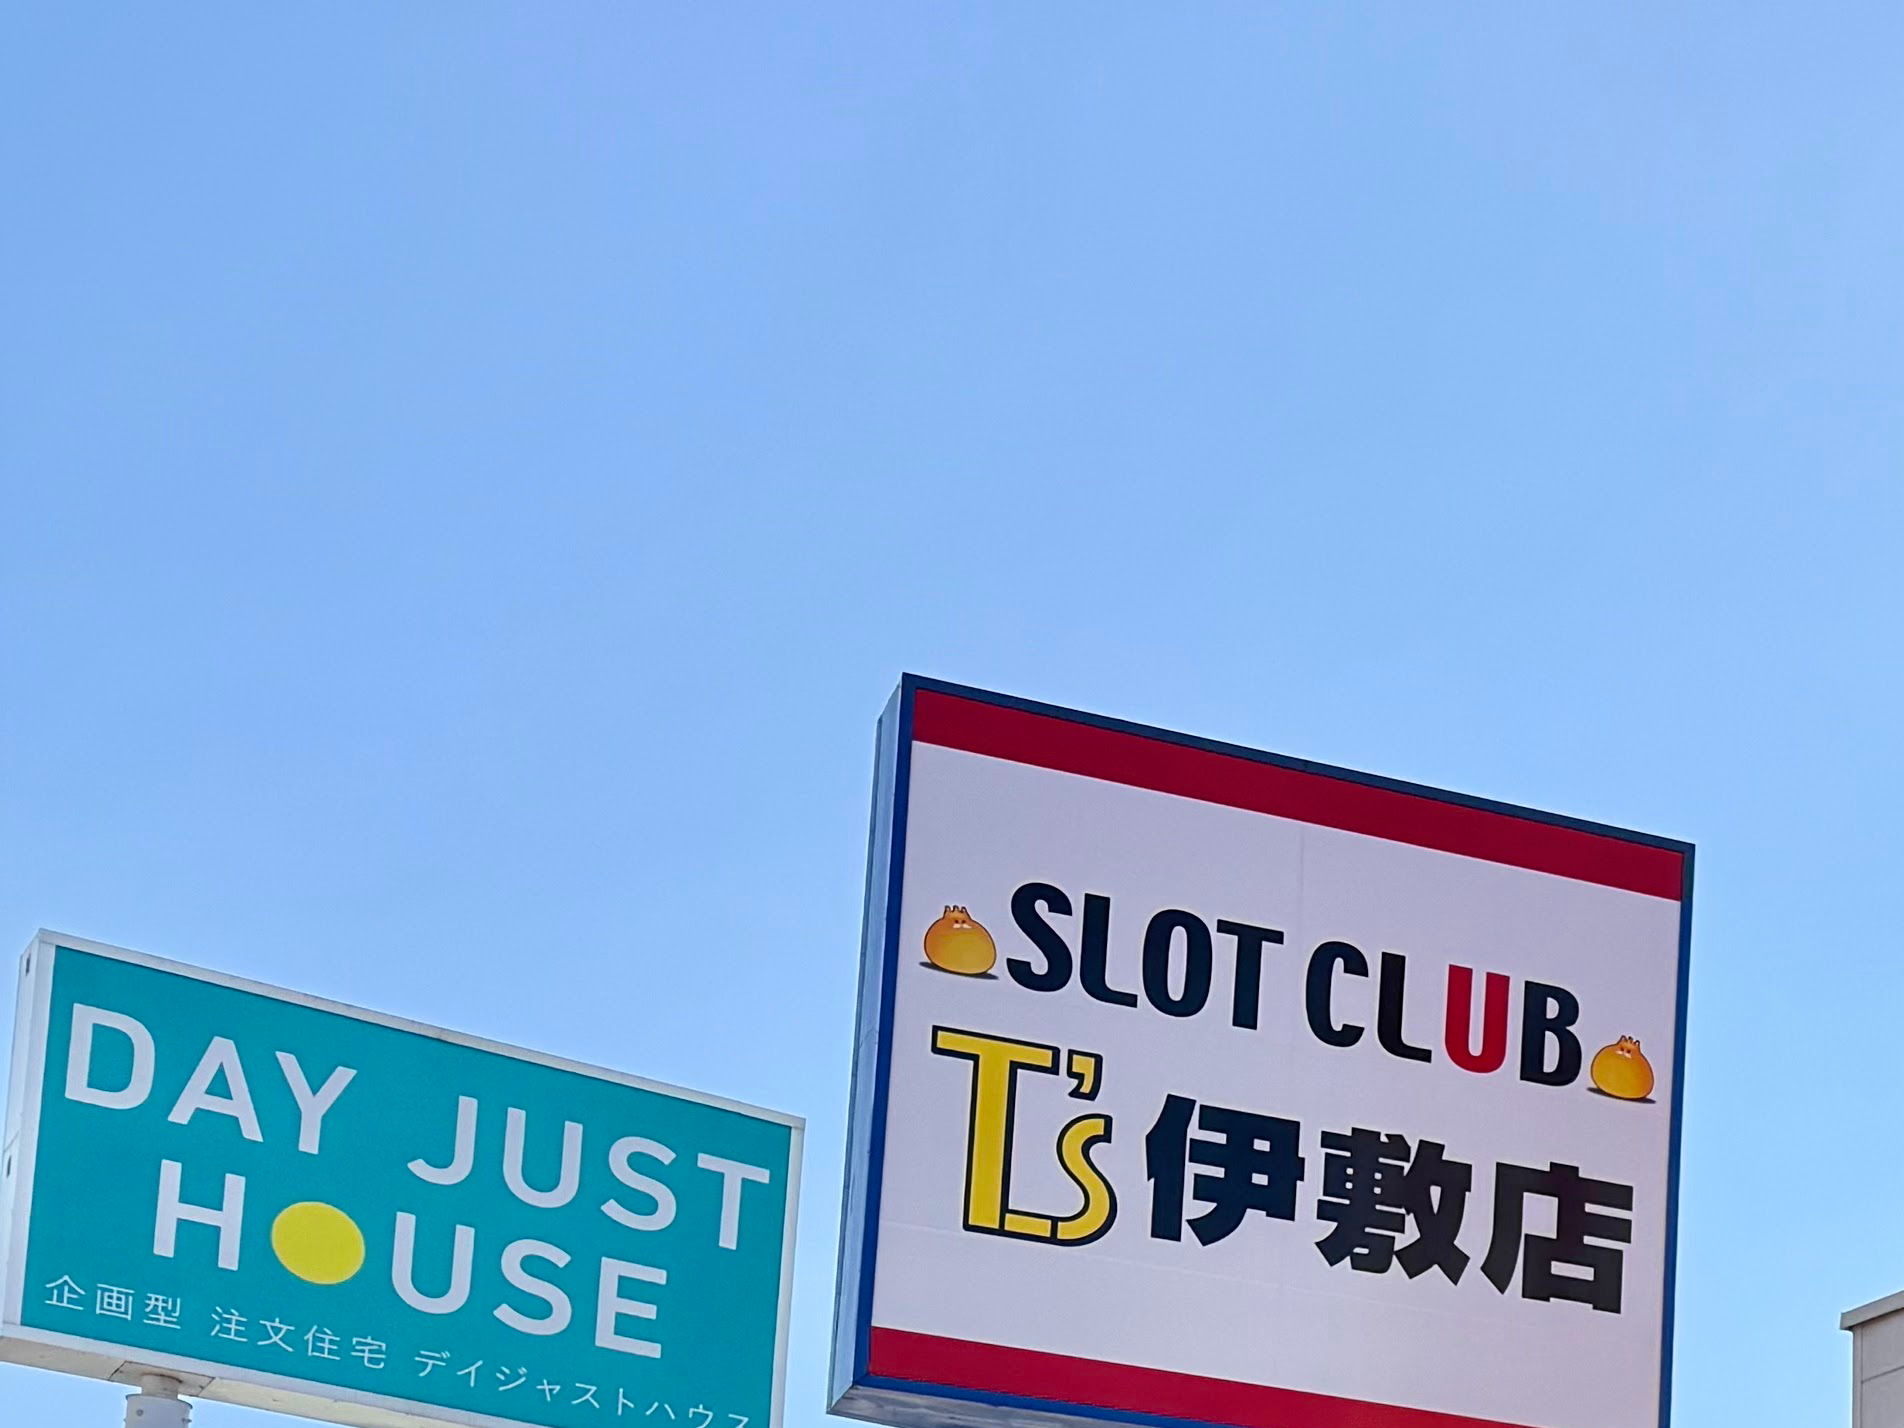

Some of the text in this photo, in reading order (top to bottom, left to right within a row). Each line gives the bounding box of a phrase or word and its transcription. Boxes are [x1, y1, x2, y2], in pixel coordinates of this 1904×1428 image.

[1006, 882, 1583, 1088] SLOT CLUB
[64, 1003, 771, 1251] DAY JUST
[1144, 1093, 1635, 1315] 伊敷店
[45, 1274, 182, 1330] 企画型
[210, 1305, 388, 1371] 注文住宅
